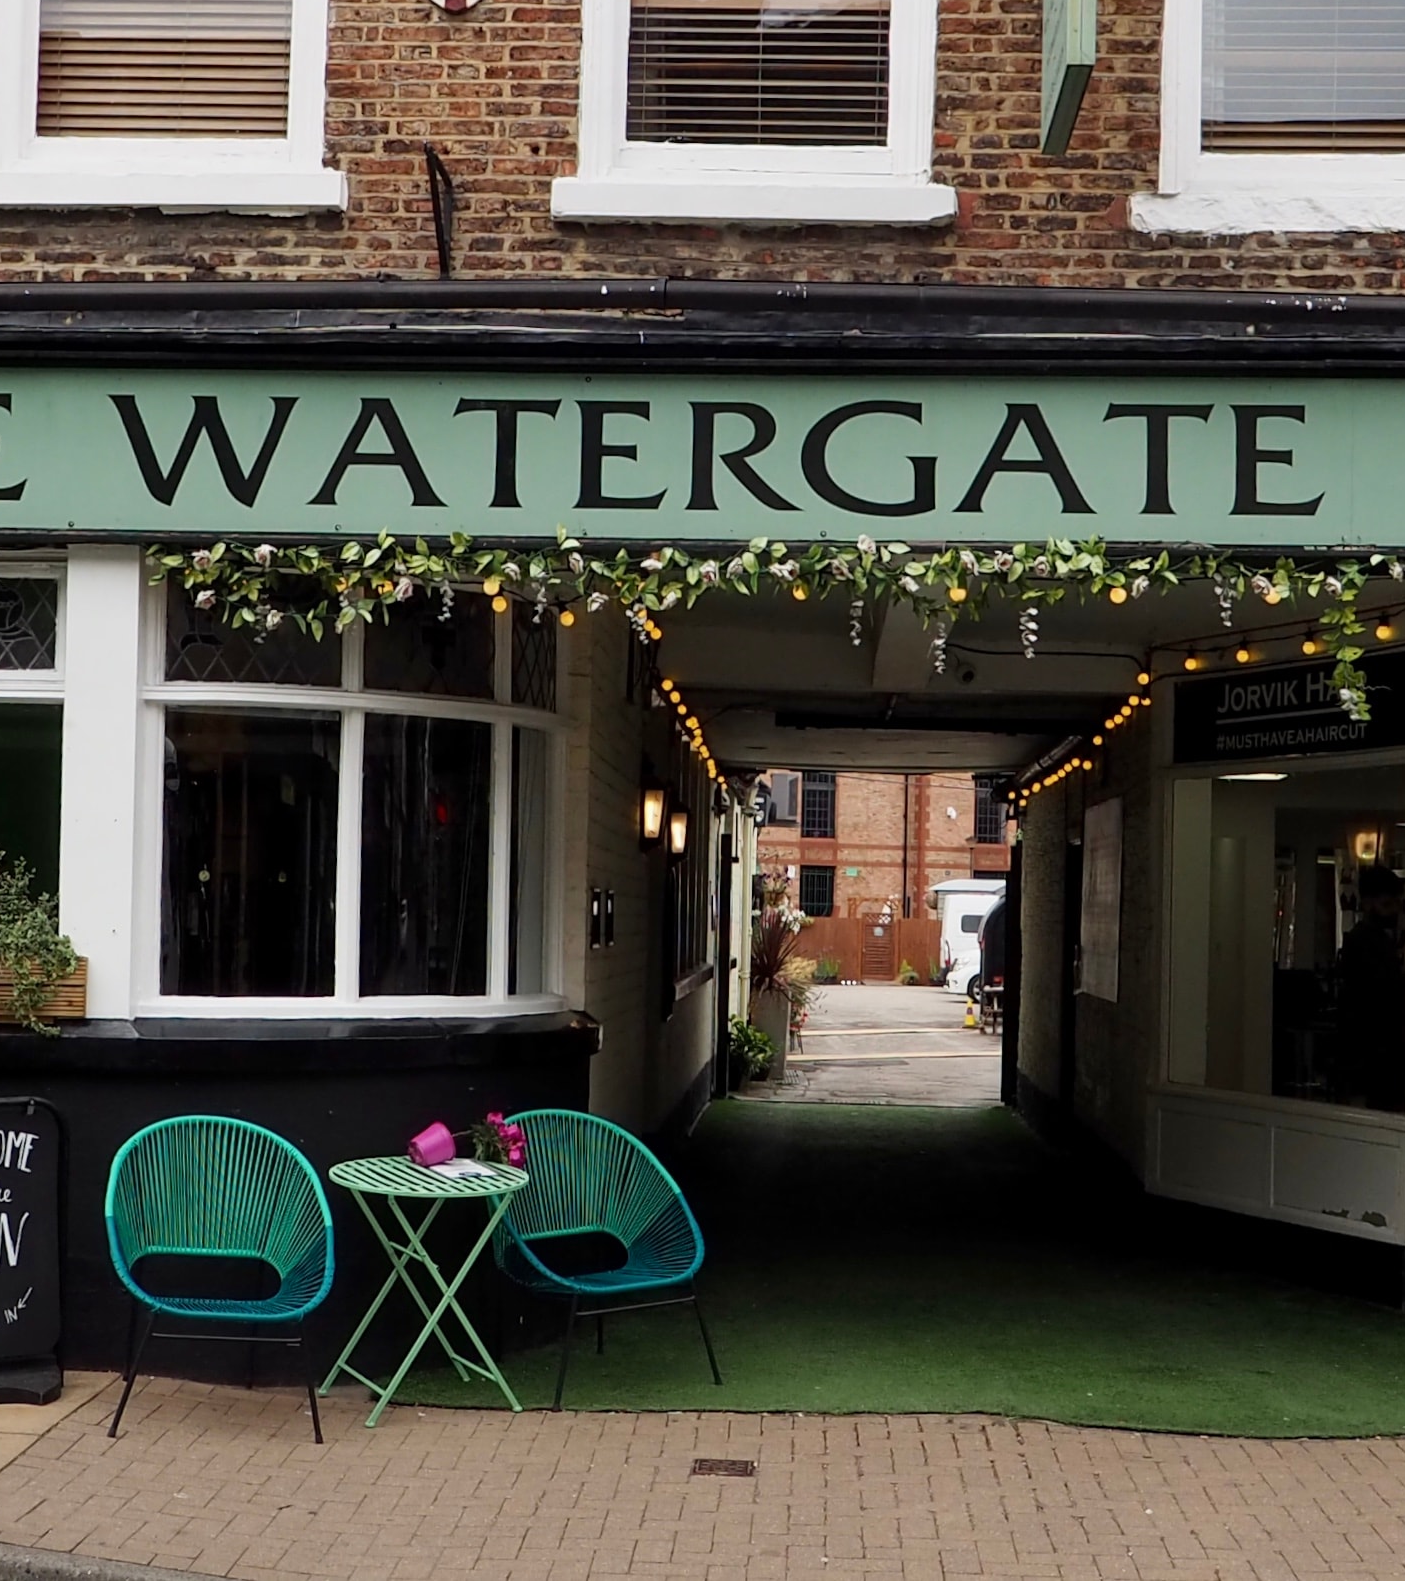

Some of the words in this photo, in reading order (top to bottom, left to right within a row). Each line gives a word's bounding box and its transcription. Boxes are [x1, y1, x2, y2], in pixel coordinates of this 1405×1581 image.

[107, 393, 1326, 518] WATERGATE
[1217, 679, 1299, 714] JORVIK
[1216, 722, 1368, 751] #MUSTHAVEAHAIRCUT
[3, 1306, 19, 1325] IN
